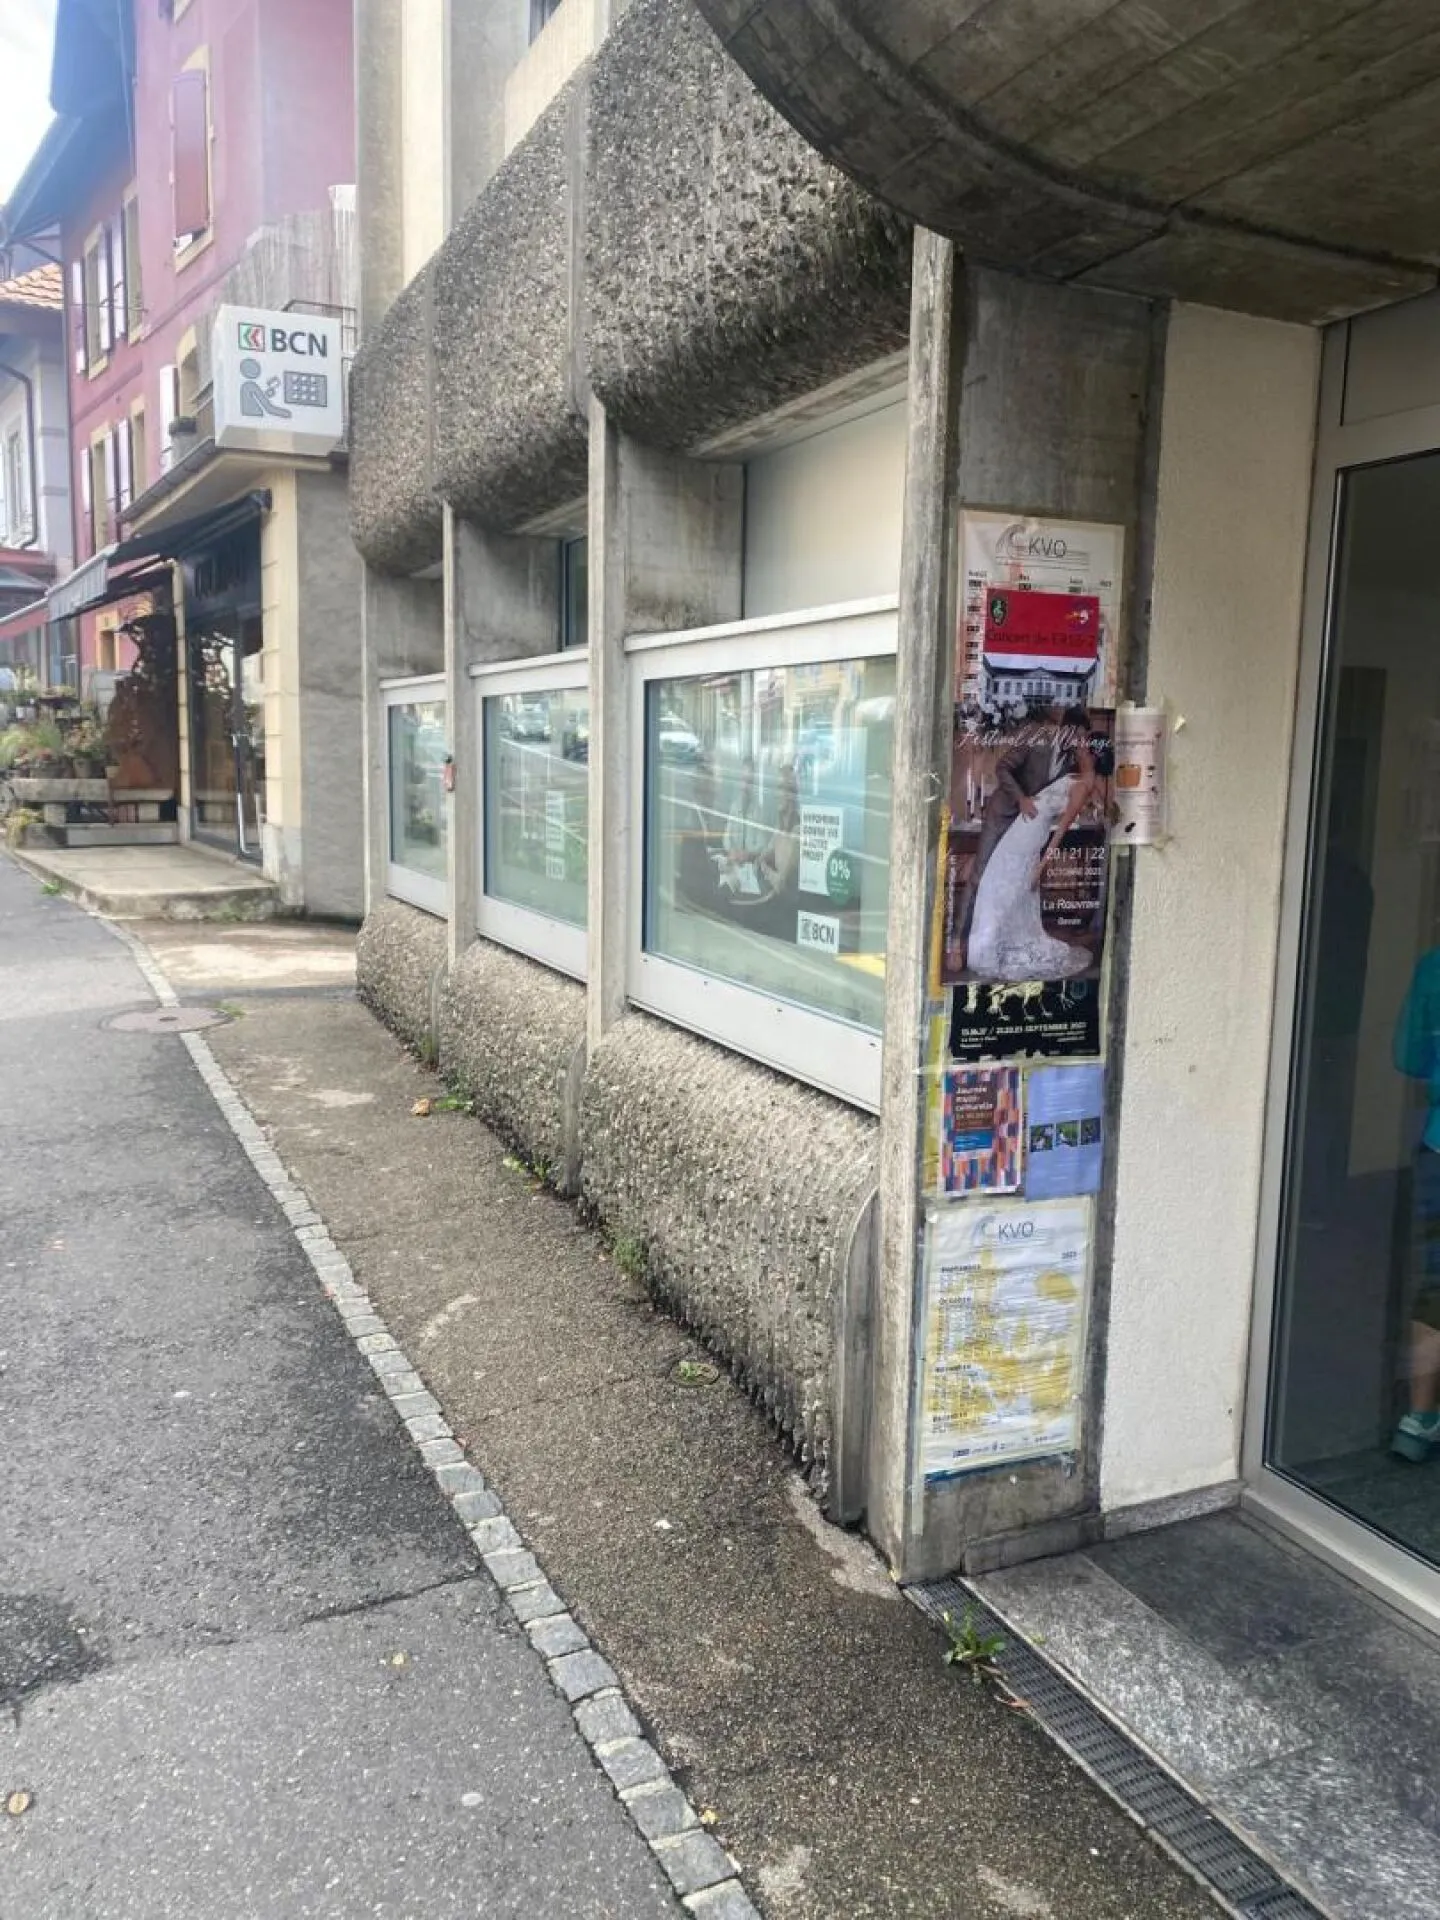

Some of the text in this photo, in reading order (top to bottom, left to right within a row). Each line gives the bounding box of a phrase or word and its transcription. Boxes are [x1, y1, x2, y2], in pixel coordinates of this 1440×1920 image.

[270, 328, 328, 358] BCN
[1046, 847, 1060, 859] 20
[1069, 847, 1082, 859] 21
[1090, 846, 1105, 859] 22
[1043, 899, 1055, 911] La
[998, 1222, 1035, 1240] KVO
